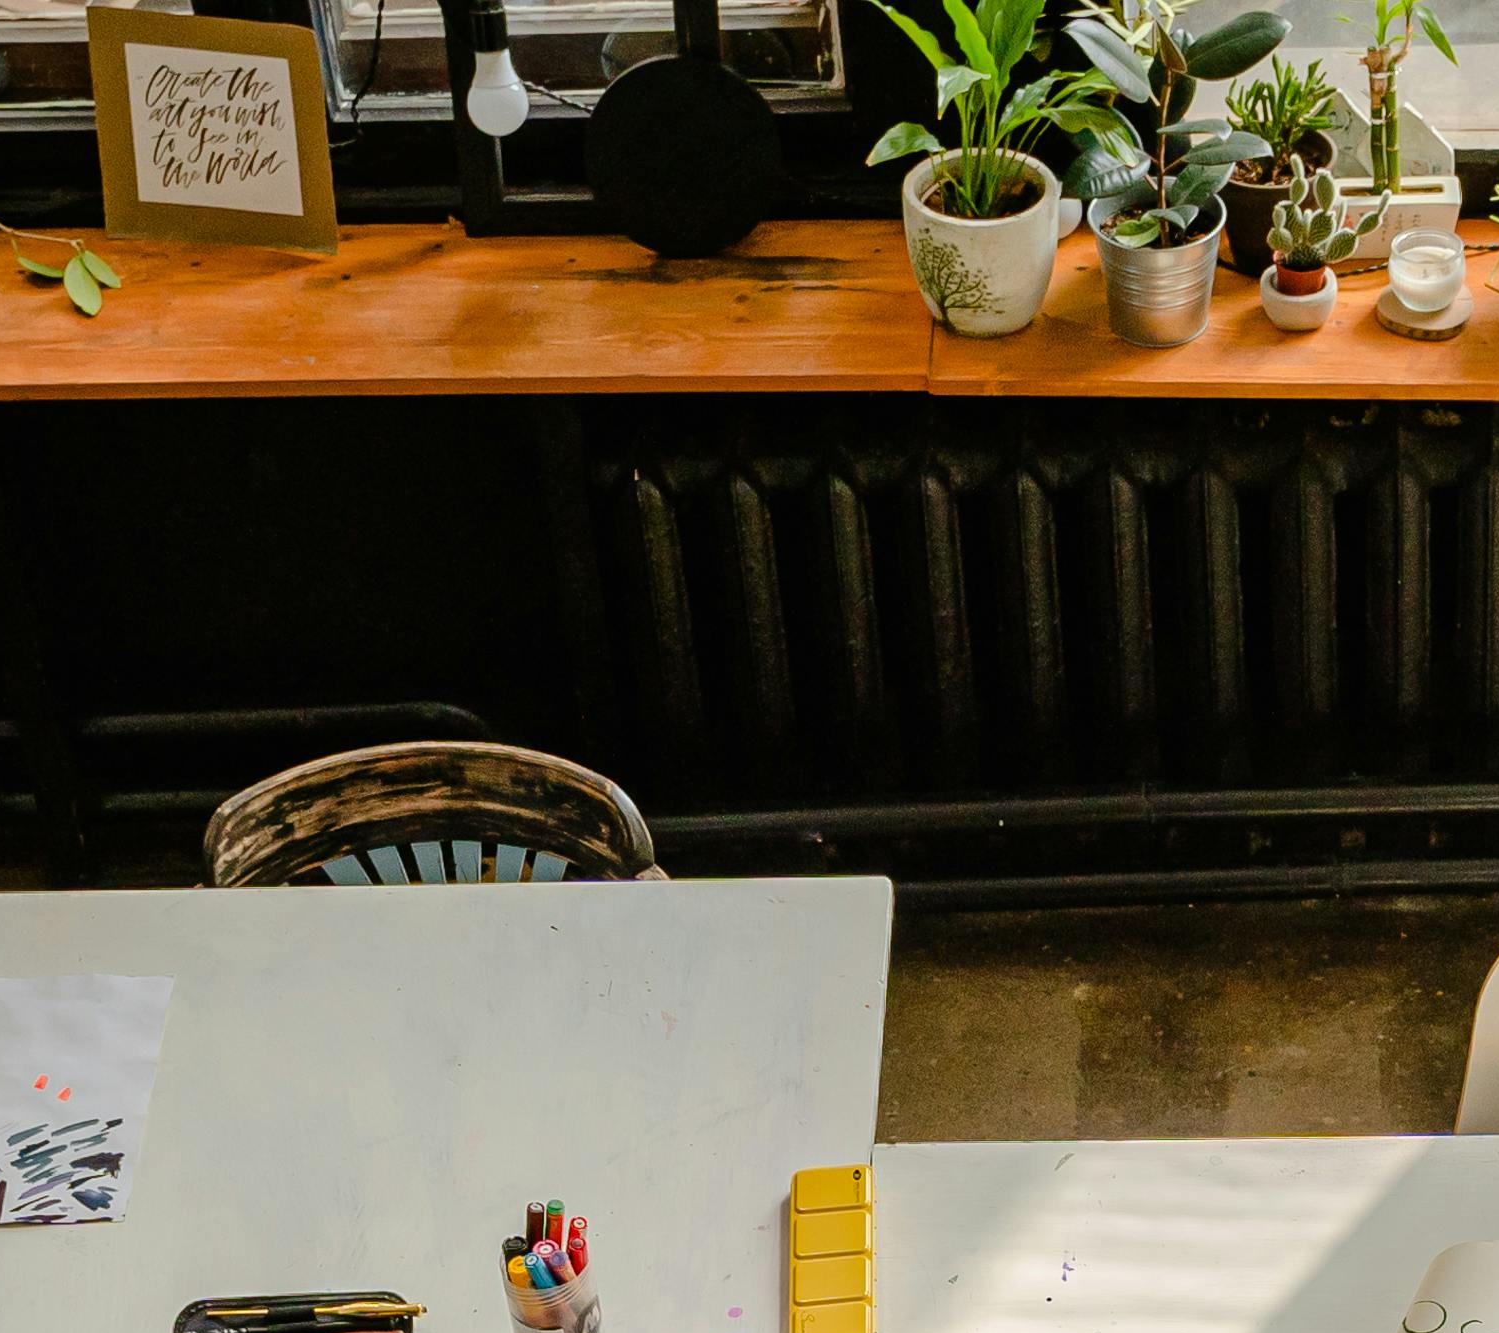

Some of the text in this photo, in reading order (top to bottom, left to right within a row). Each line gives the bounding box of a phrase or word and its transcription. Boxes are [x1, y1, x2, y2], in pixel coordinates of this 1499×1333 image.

[145, 65, 226, 107] Create
[149, 97, 286, 138] art you wish
[151, 131, 176, 166] to
